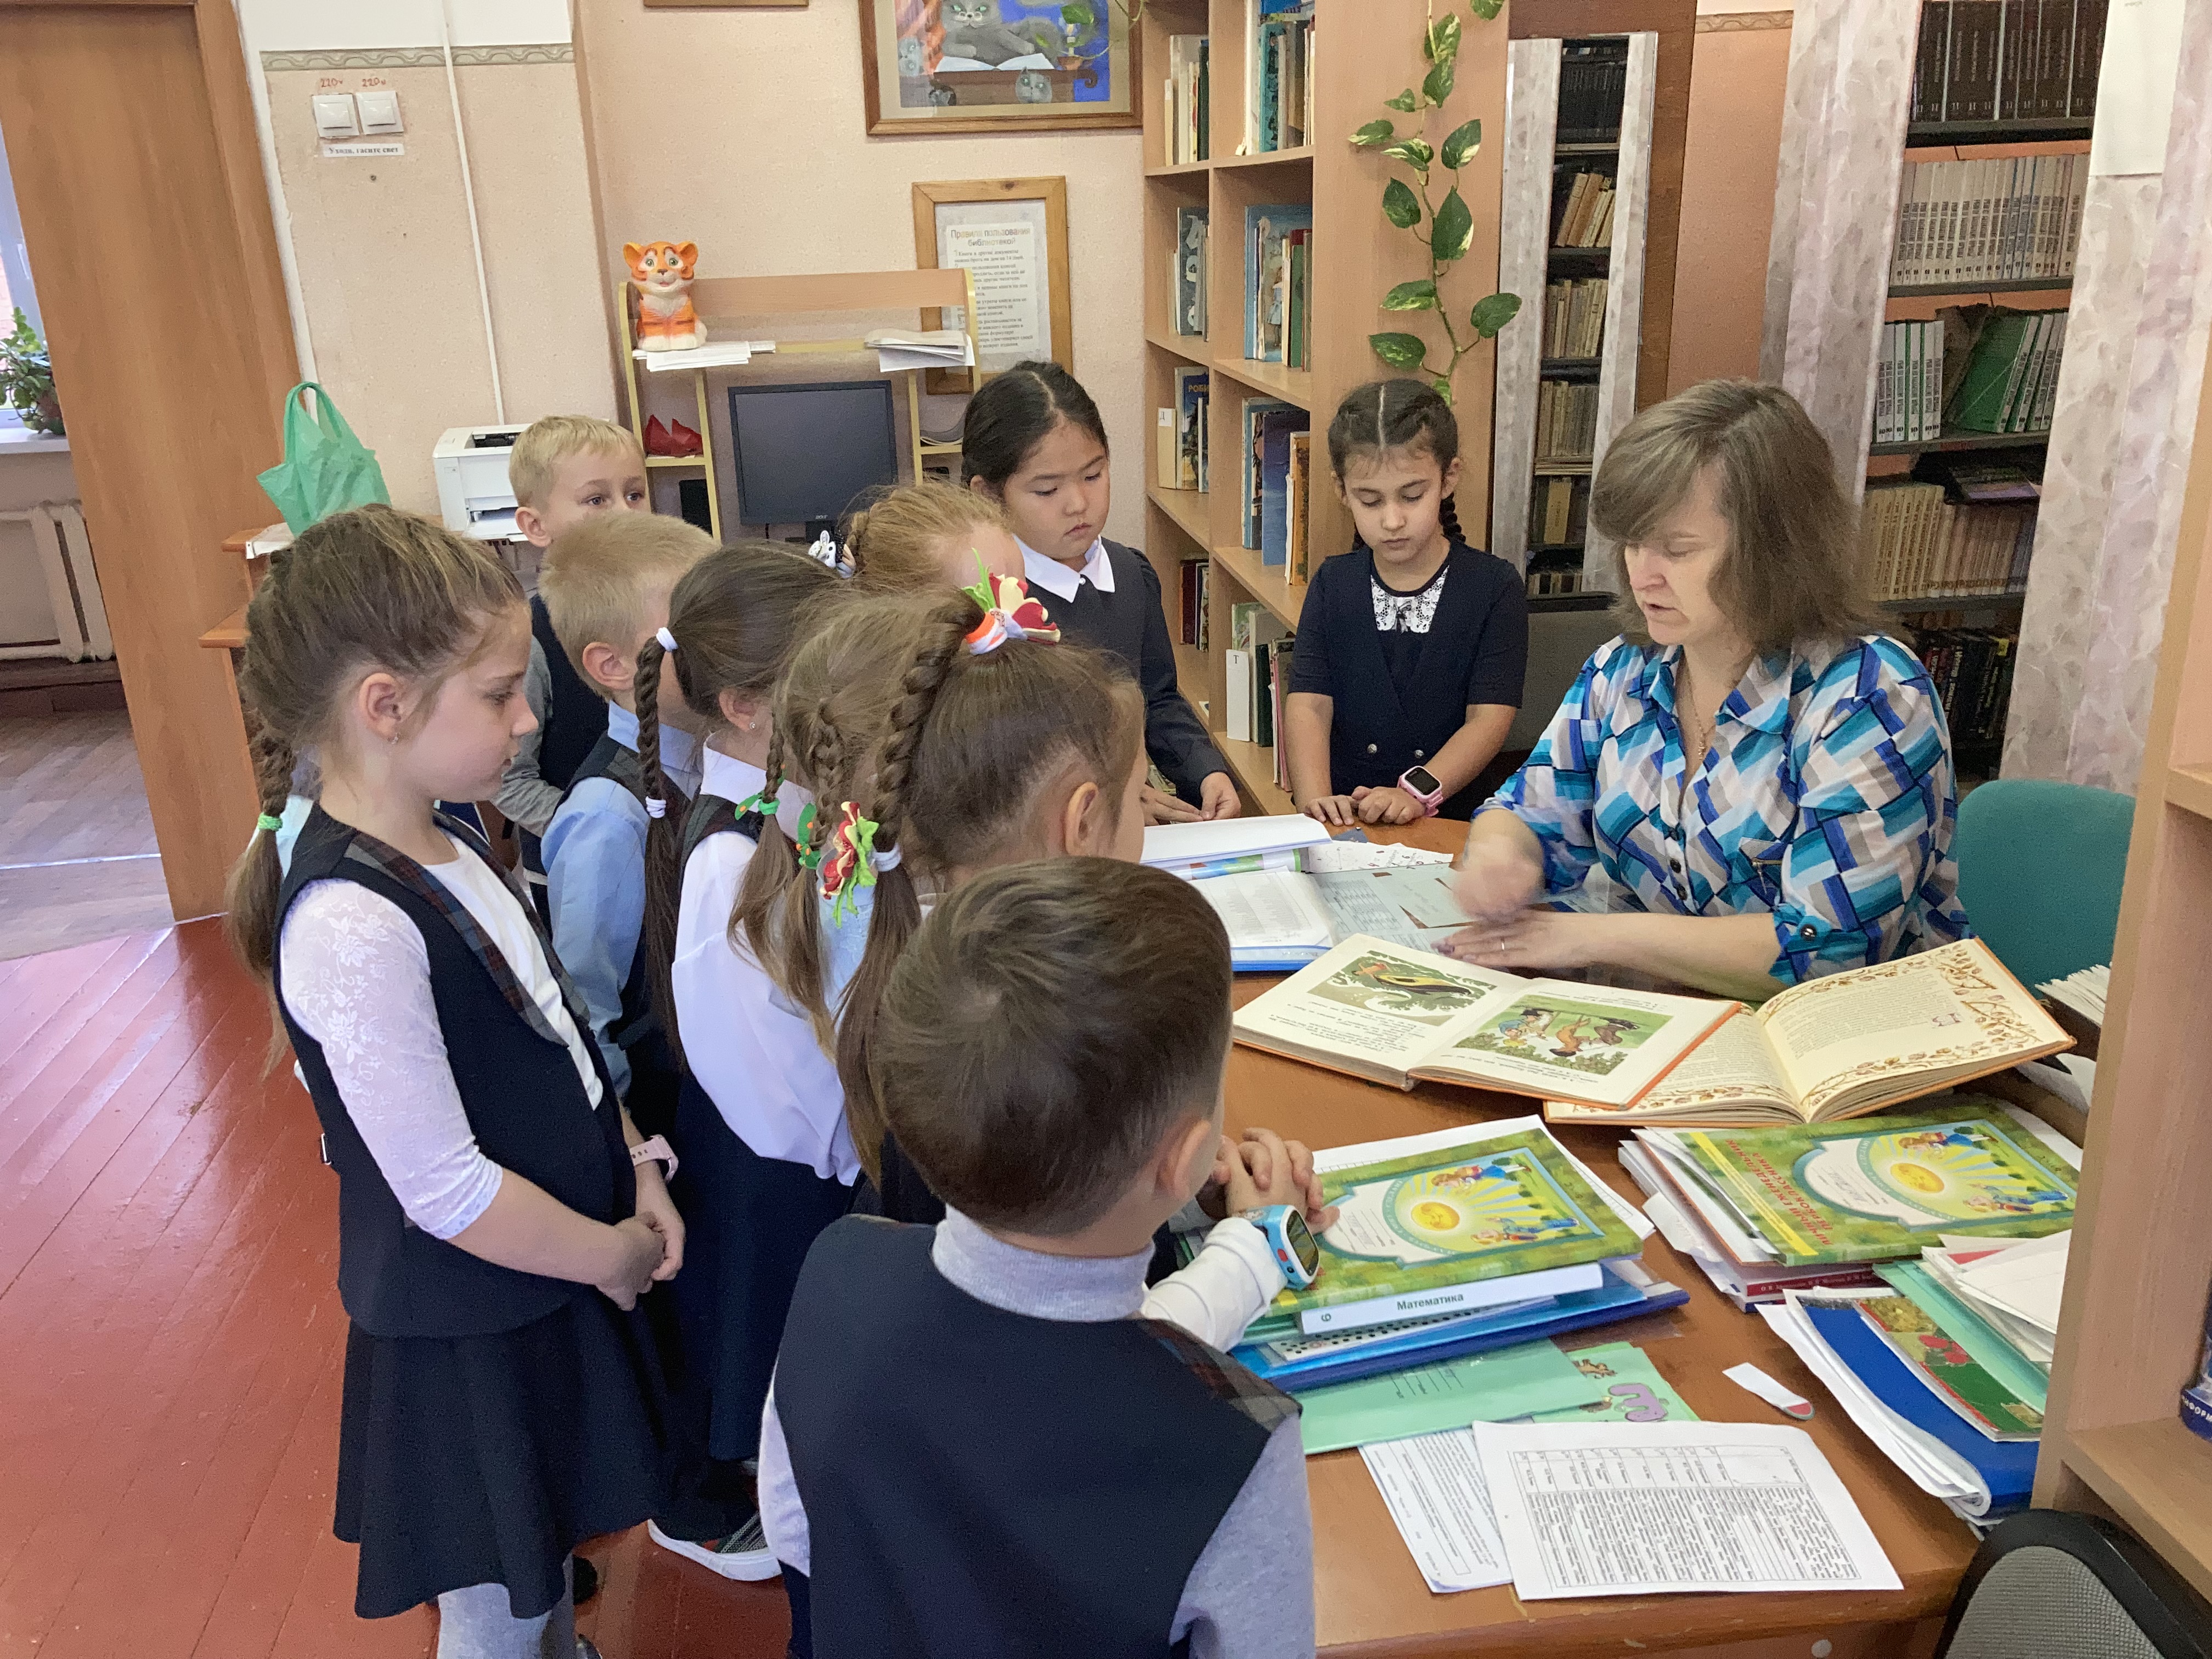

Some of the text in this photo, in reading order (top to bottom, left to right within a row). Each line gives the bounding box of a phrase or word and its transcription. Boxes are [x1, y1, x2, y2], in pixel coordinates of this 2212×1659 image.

[951, 228, 1031, 240] Правила пользования
[967, 238, 1016, 246] библиотекой
[1725, 1139, 1793, 1206] ЕЖЕНЕДЕЛЬНИК
[1752, 1152, 1833, 1231] ПЕРВОКЛАССНИКА
[1396, 1293, 1464, 1311] Математика
